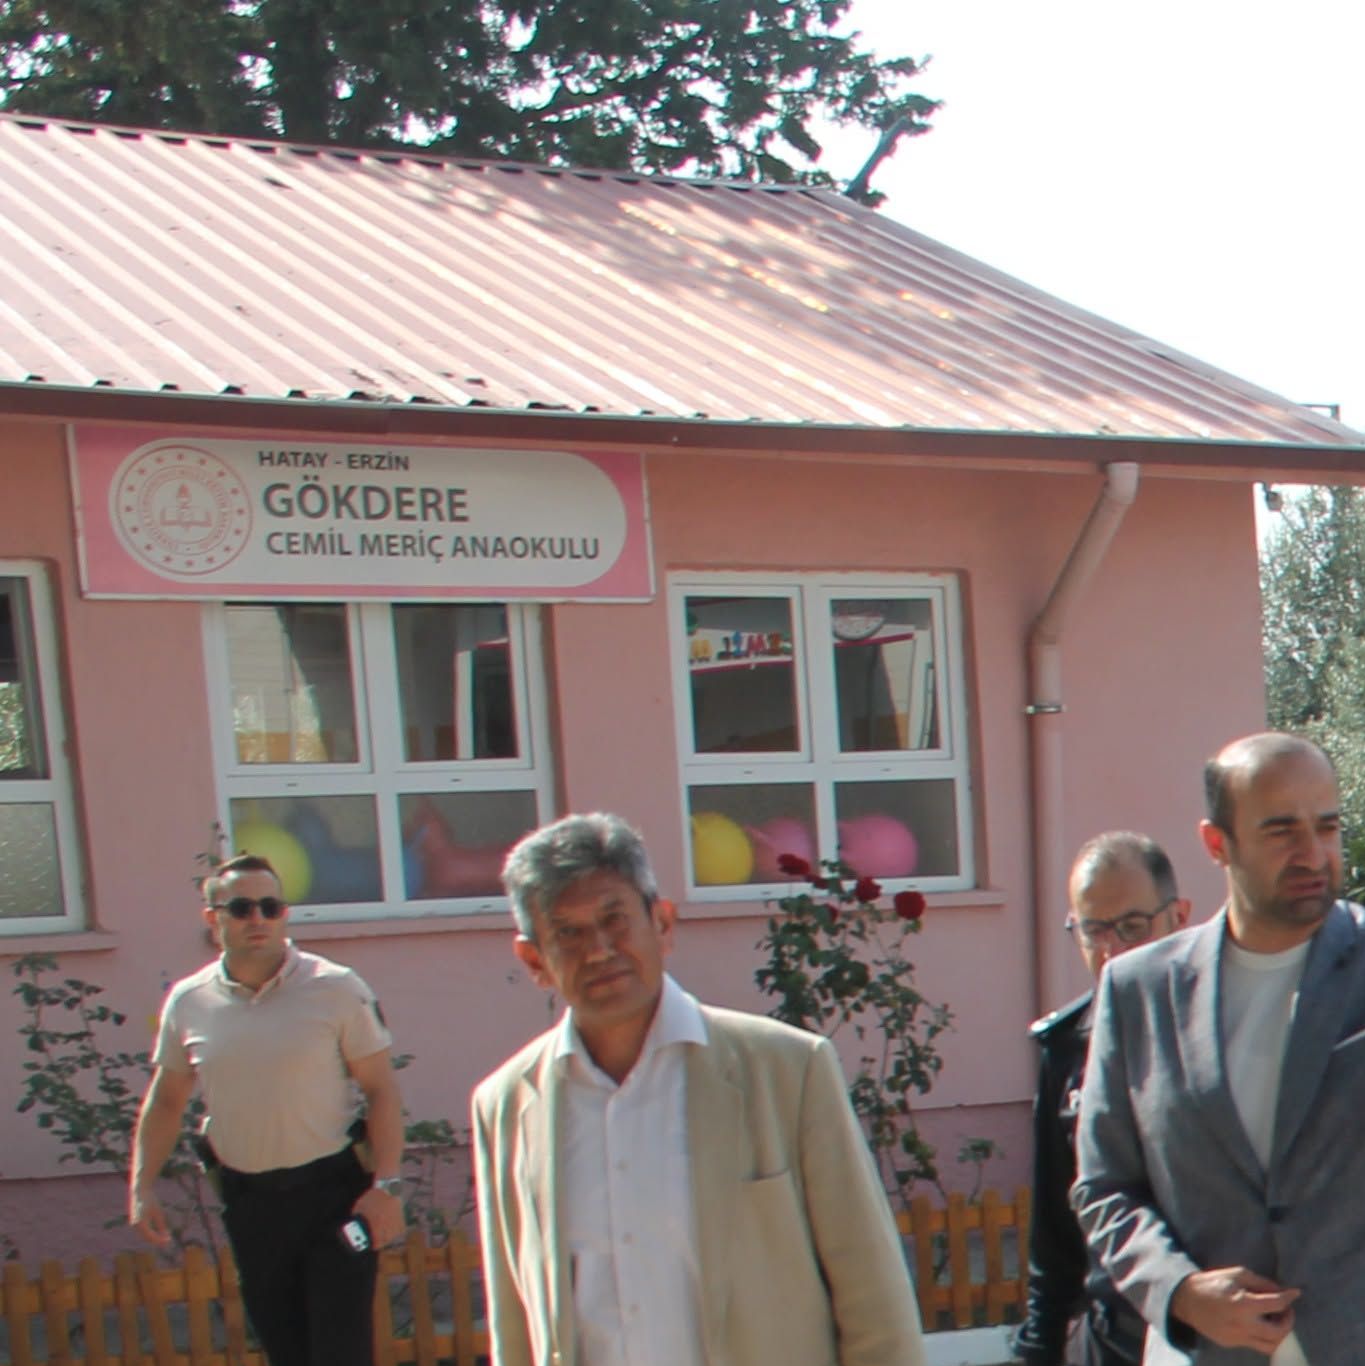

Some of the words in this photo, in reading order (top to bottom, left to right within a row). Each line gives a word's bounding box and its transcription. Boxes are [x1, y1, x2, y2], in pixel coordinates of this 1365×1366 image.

[258, 451, 328, 468] HATAY
[347, 451, 410, 471] ERZİN
[263, 474, 470, 522] GÖKDERE
[266, 527, 353, 556] CEMİL
[360, 529, 444, 563] MERİÇ
[451, 536, 600, 559] ANAOKULU
